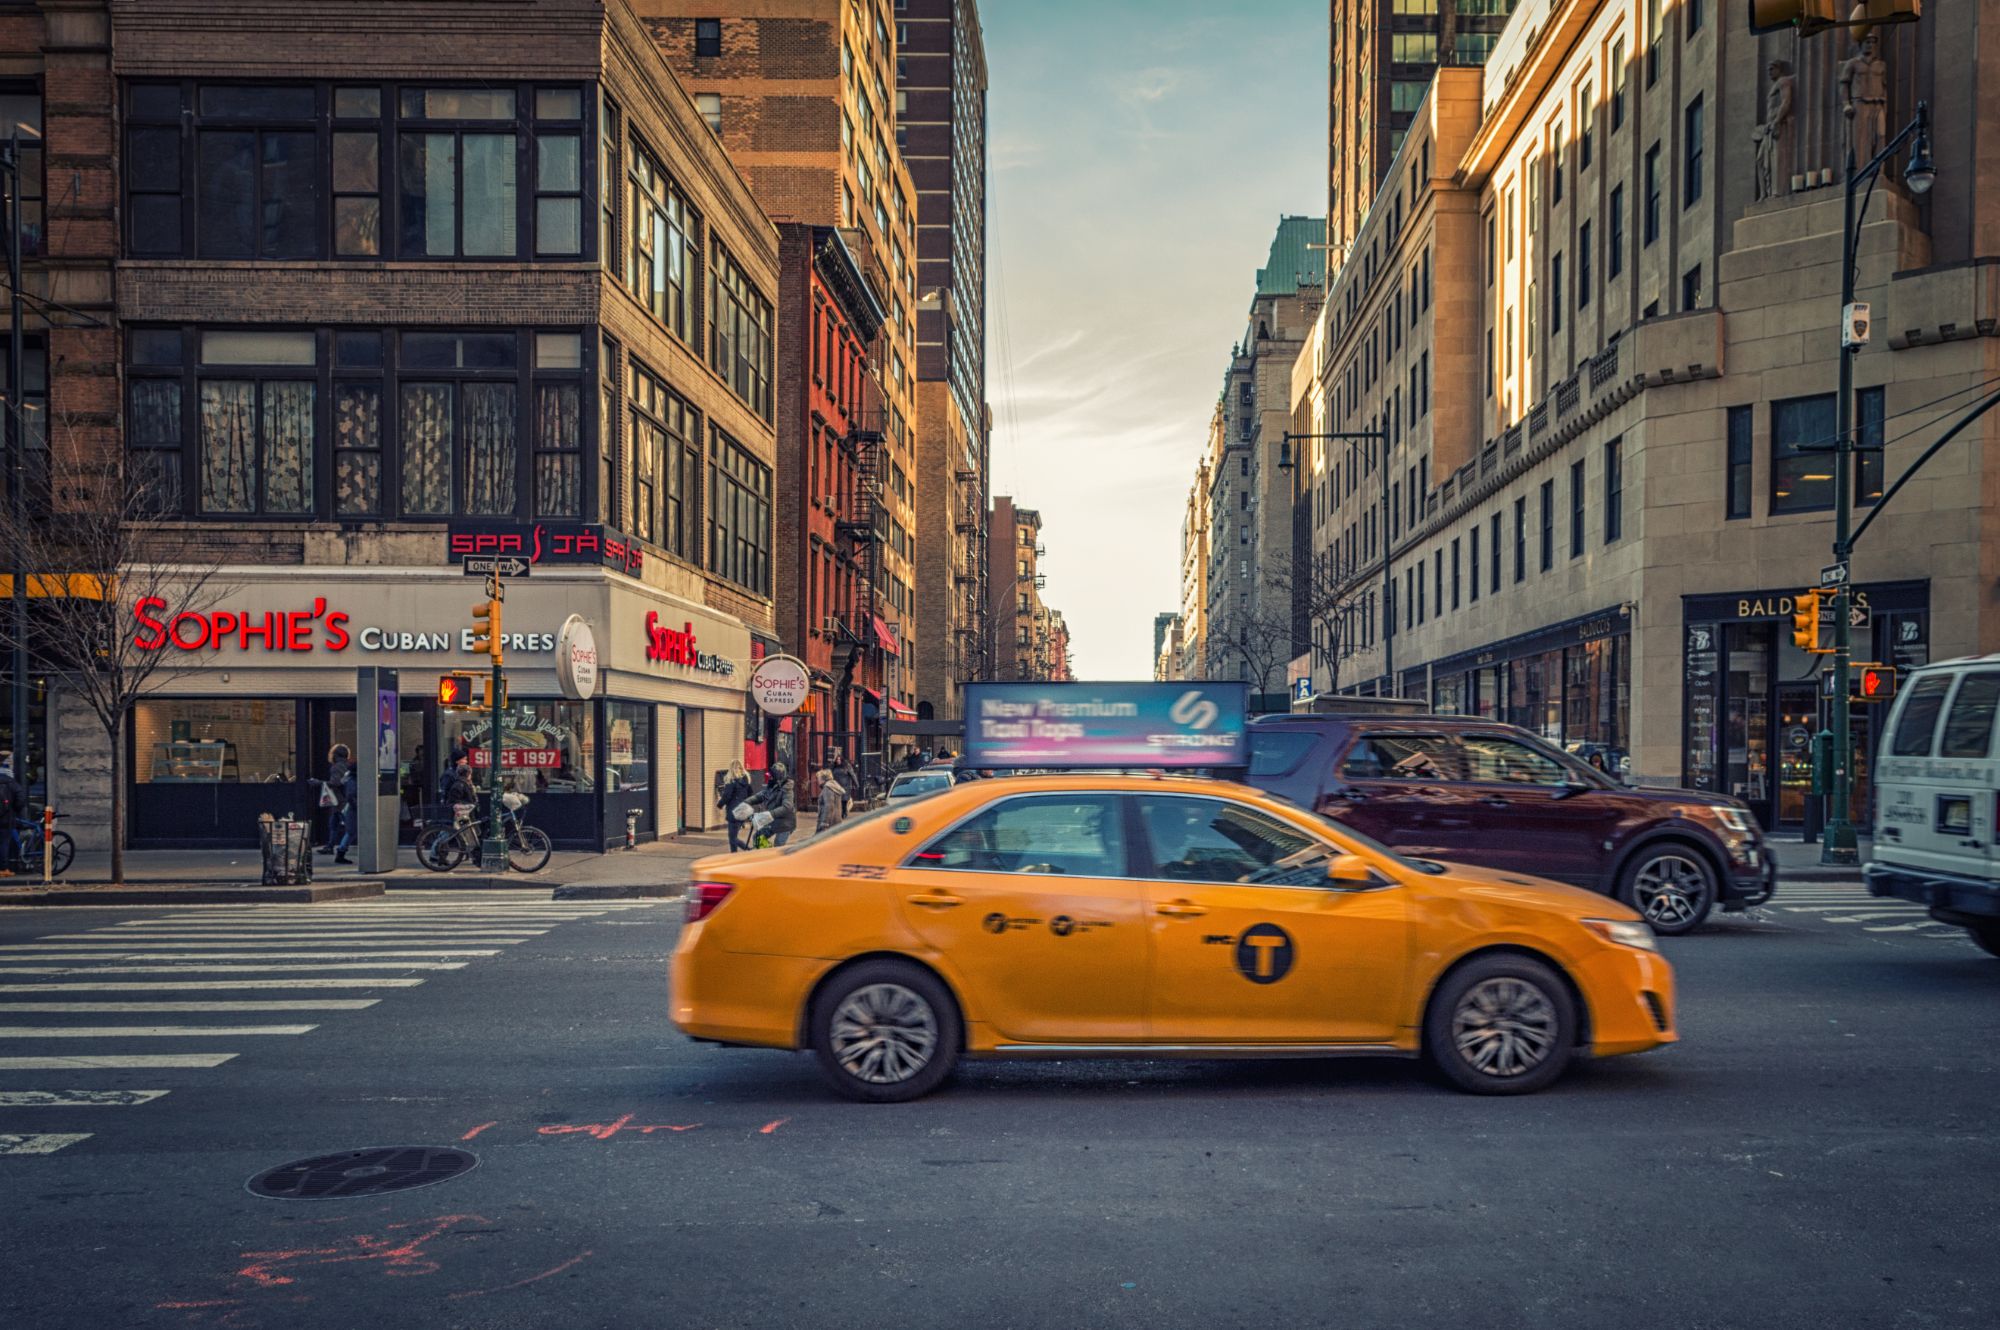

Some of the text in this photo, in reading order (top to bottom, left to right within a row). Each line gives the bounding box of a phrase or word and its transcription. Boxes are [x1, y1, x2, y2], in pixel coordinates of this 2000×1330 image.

[452, 535, 521, 552] SPA
[604, 538, 625, 561] SPA
[473, 562, 520, 571] ONE WAY
[1738, 592, 1867, 617] BALD'S
[134, 596, 349, 650] SOPHIE'S
[360, 627, 449, 650] CUBAN
[461, 628, 554, 650] EPRES
[646, 611, 696, 668] SOPHIE'S
[572, 644, 596, 665] SOPHIE'S
[577, 674, 592, 684] EXPRESS
[578, 665, 591, 674] CUBAN
[755, 675, 805, 689] SOPHIE'S
[982, 698, 1138, 717] New Premium
[462, 714, 566, 742] Celebring 20 Years
[475, 751, 556, 765] SICE 1997
[1245, 935, 1287, 977] T
